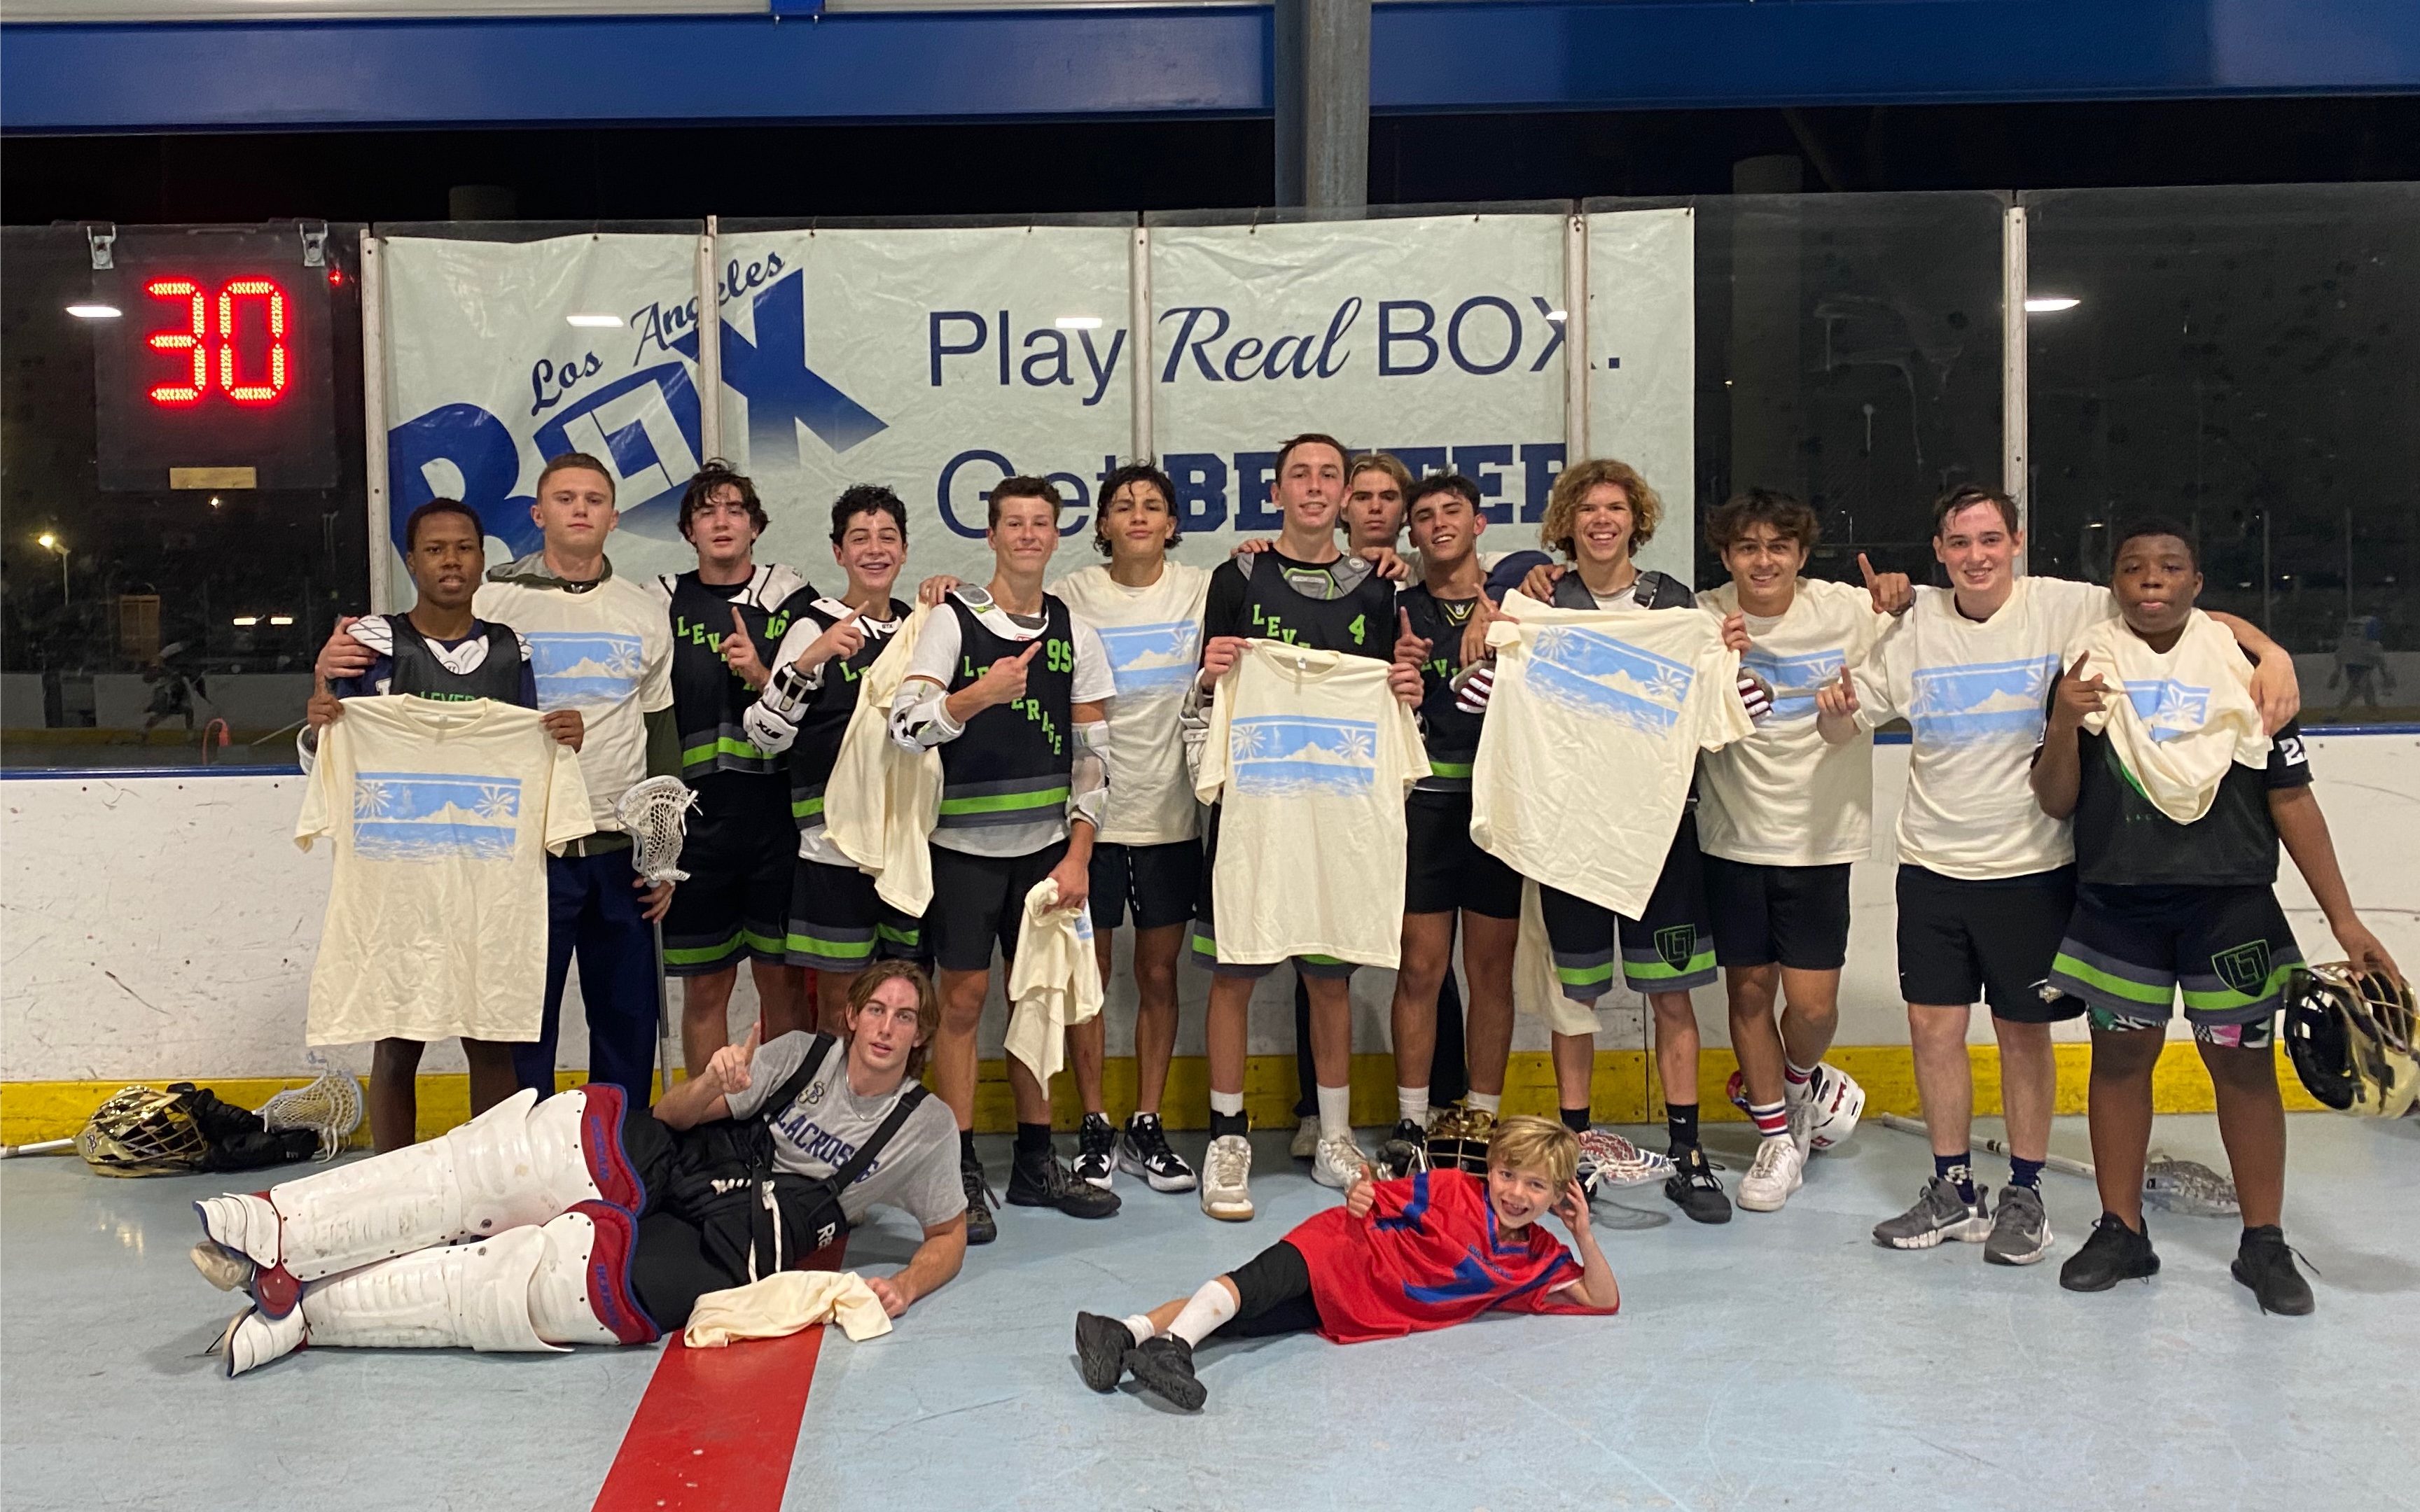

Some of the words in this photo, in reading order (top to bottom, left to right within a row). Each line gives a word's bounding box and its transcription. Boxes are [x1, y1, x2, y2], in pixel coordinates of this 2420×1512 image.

[147, 280, 286, 402] 30
[929, 309, 1127, 406] Play
[1157, 296, 1362, 383] Real
[1378, 295, 1620, 376] BOX.
[531, 350, 604, 416] Los
[1348, 613, 1365, 645] 4
[2278, 734, 2307, 766] 2
[776, 1100, 880, 1184] LACROSE
